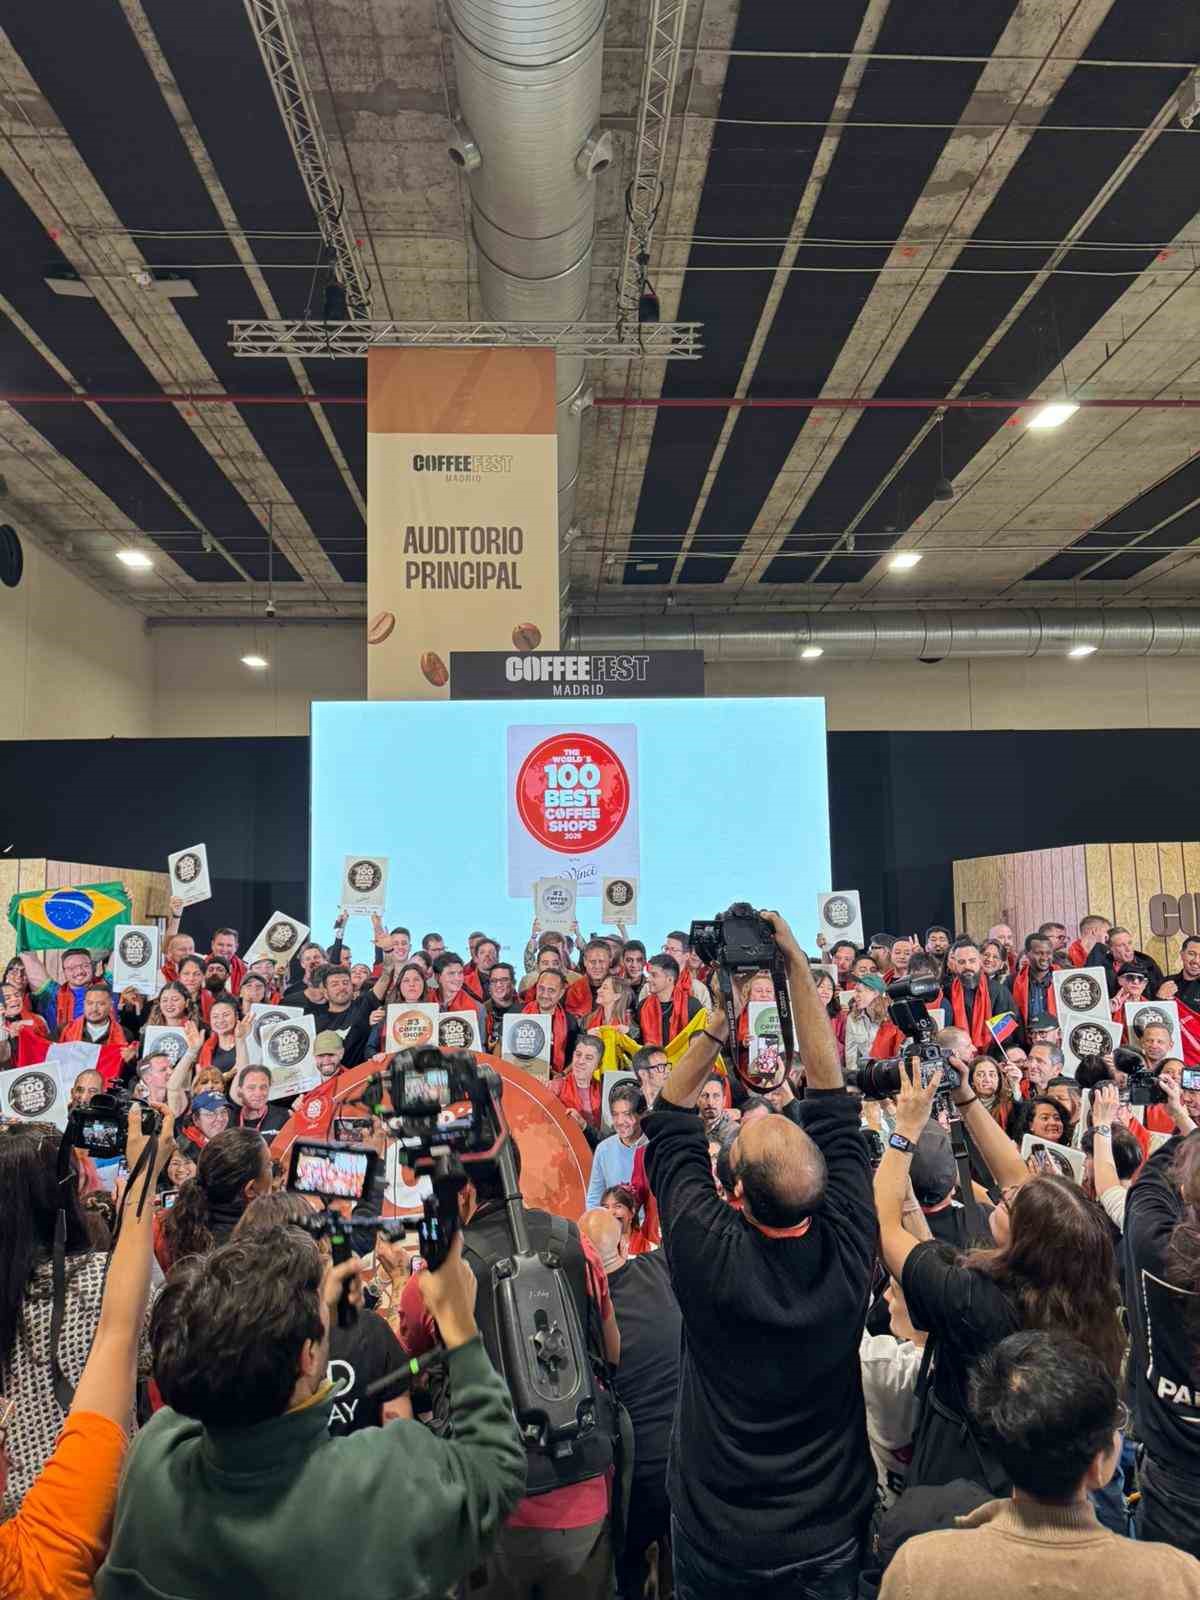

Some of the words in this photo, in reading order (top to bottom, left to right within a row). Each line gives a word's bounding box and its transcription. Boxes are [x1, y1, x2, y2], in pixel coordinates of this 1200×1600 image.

[445, 474, 481, 483] MADRID
[403, 526, 524, 554] AUDITORIO
[405, 561, 523, 589] PRINCIPAL
[552, 684, 605, 696] MADRID
[544, 763, 601, 788] 100
[544, 789, 602, 807] BEST
[544, 808, 601, 820] COFFEE
[548, 820, 597, 832] SHOPS
[127, 940, 143, 948] 100
[1070, 982, 1090, 991] 100
[445, 1024, 464, 1033] 100
[517, 1030, 536, 1038] 100
[1081, 1030, 1103, 1042] 100
[160, 1041, 179, 1051] 100
[19, 1080, 44, 1095] 100
